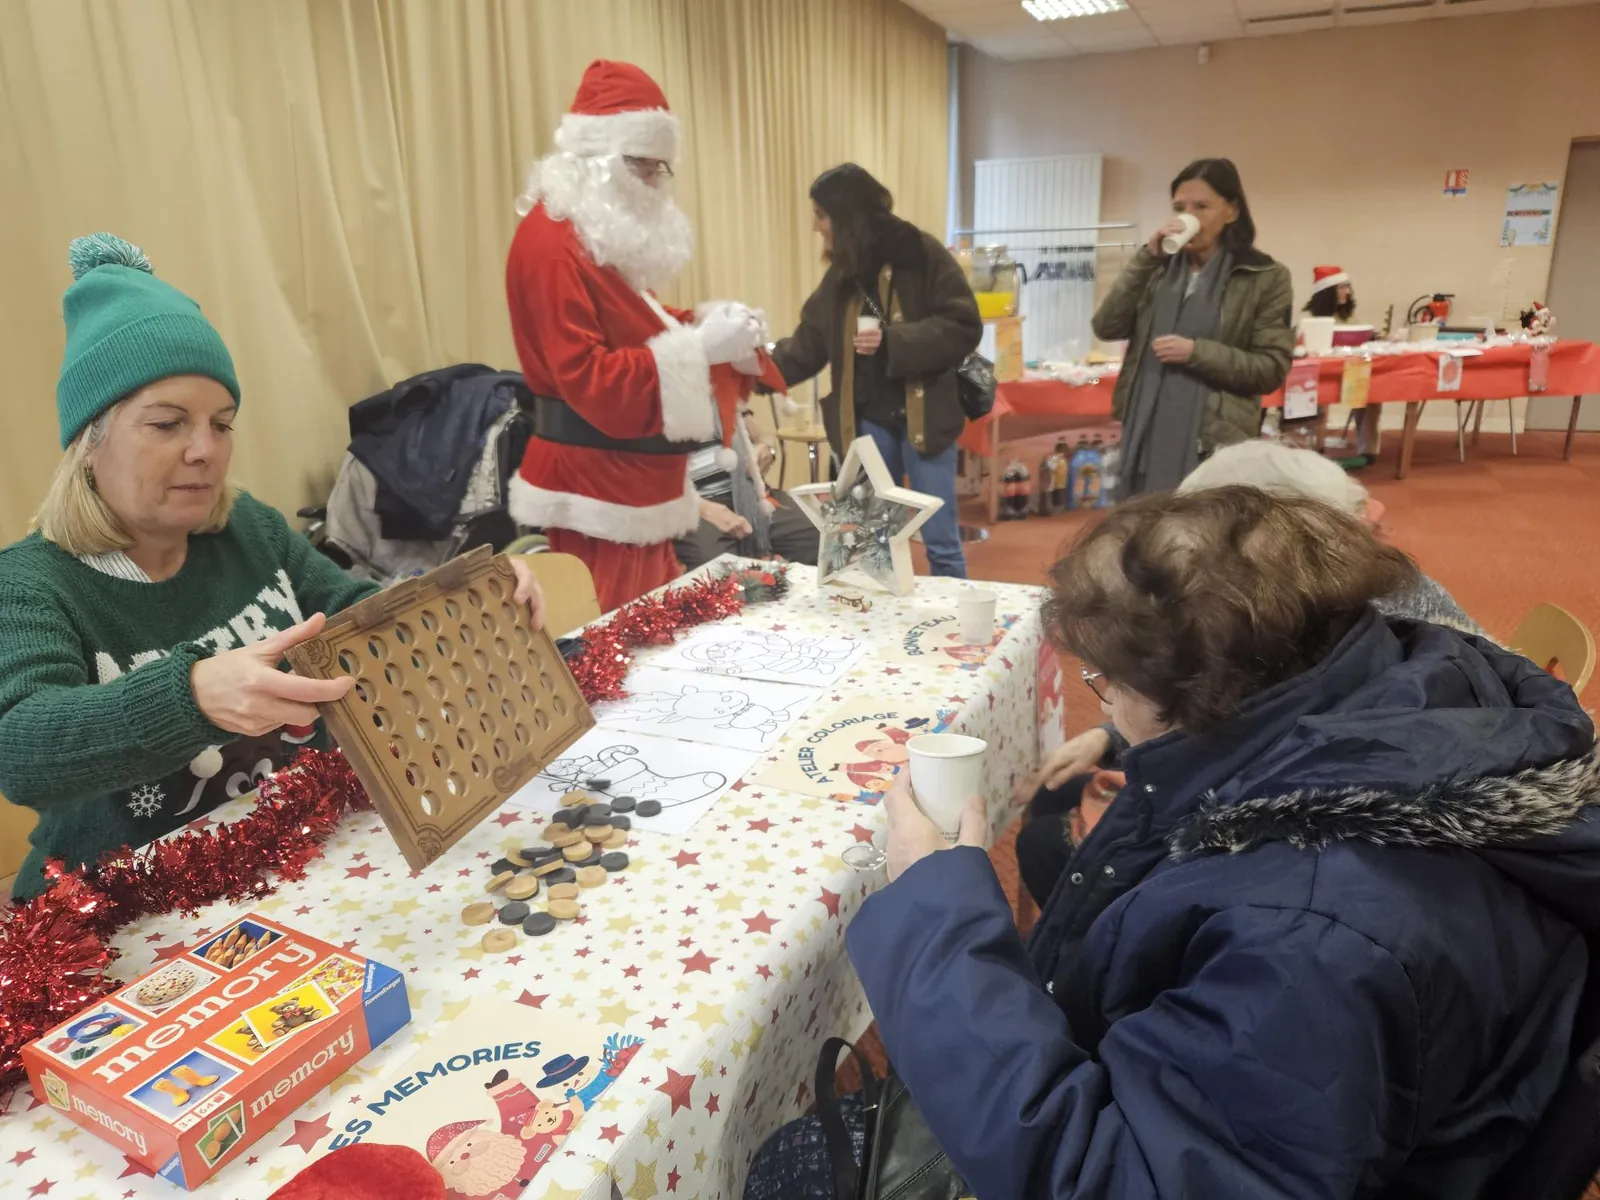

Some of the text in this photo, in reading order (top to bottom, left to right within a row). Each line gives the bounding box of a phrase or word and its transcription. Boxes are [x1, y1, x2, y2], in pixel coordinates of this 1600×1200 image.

[902, 614, 957, 656] BONNETEAU
[797, 711, 899, 784] ATELIER COLORIAGE
[250, 1024, 355, 1118] memory
[366, 1041, 542, 1116] MEMORIES
[71, 1094, 148, 1157] memory
